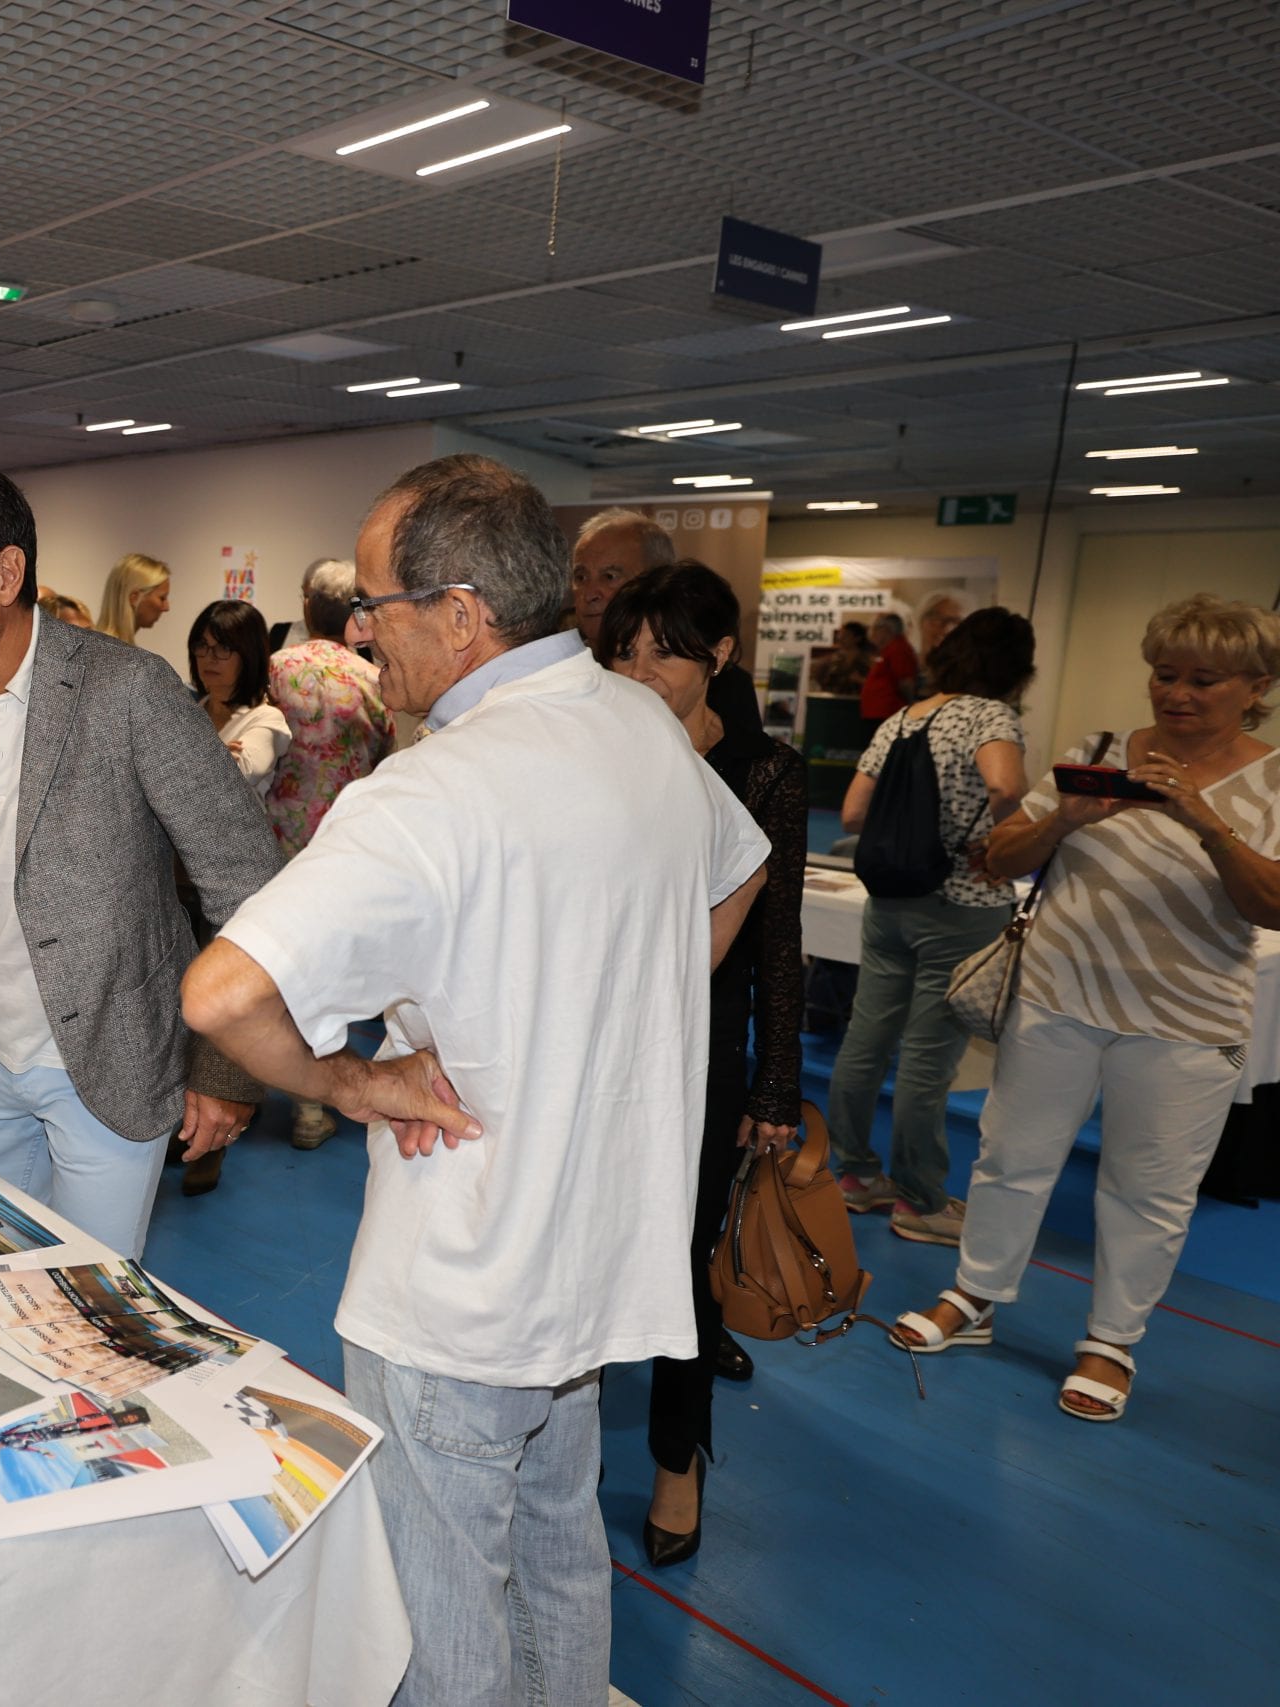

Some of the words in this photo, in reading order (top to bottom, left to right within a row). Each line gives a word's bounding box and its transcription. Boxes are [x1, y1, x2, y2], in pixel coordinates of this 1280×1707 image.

[776, 594, 801, 606] on
[809, 593, 830, 606] se
[838, 592, 885, 606] sent
[23, 1293, 41, 1311] SAISON
